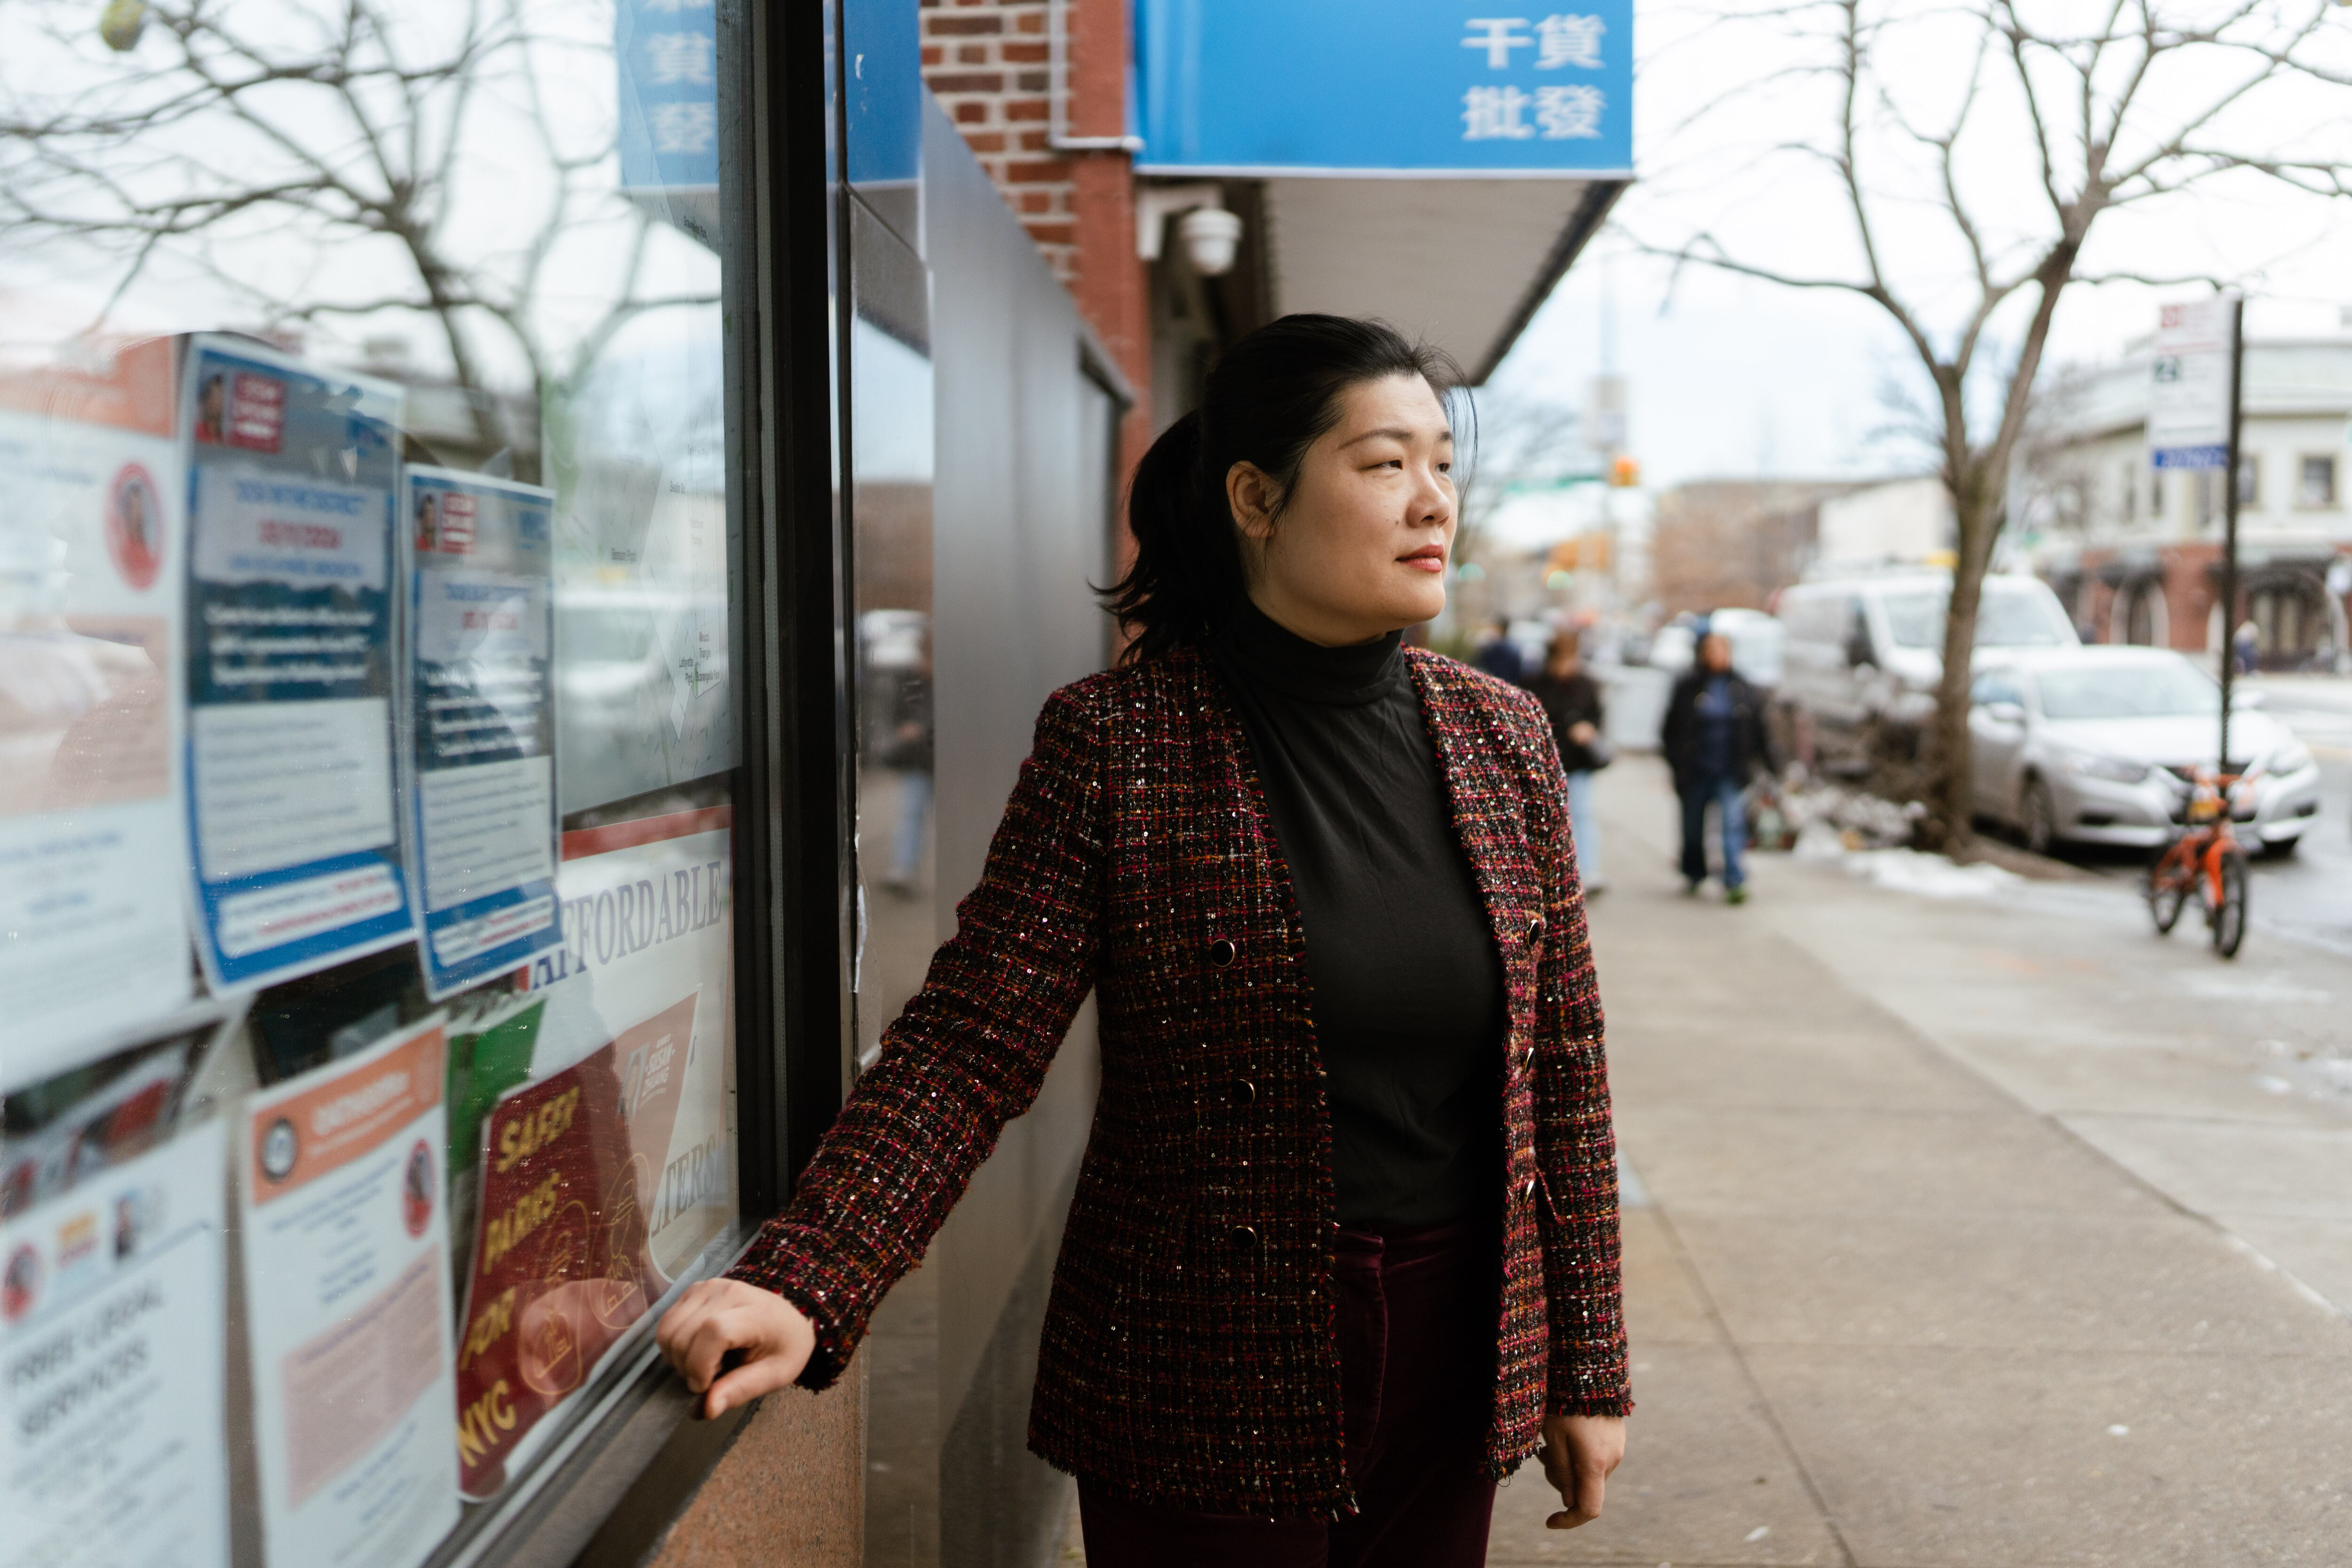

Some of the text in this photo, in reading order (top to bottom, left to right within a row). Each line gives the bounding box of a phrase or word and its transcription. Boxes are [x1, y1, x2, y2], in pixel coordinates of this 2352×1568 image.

[1460, 13, 1607, 70] 干貨
[1461, 85, 1607, 140] 批發
[699, 631, 710, 642] Meucci
[699, 647, 711, 660] Triangle
[679, 657, 693, 669] Lafayette
[696, 670, 713, 684] Scarangella
[456, 1379, 517, 1467] NYC
